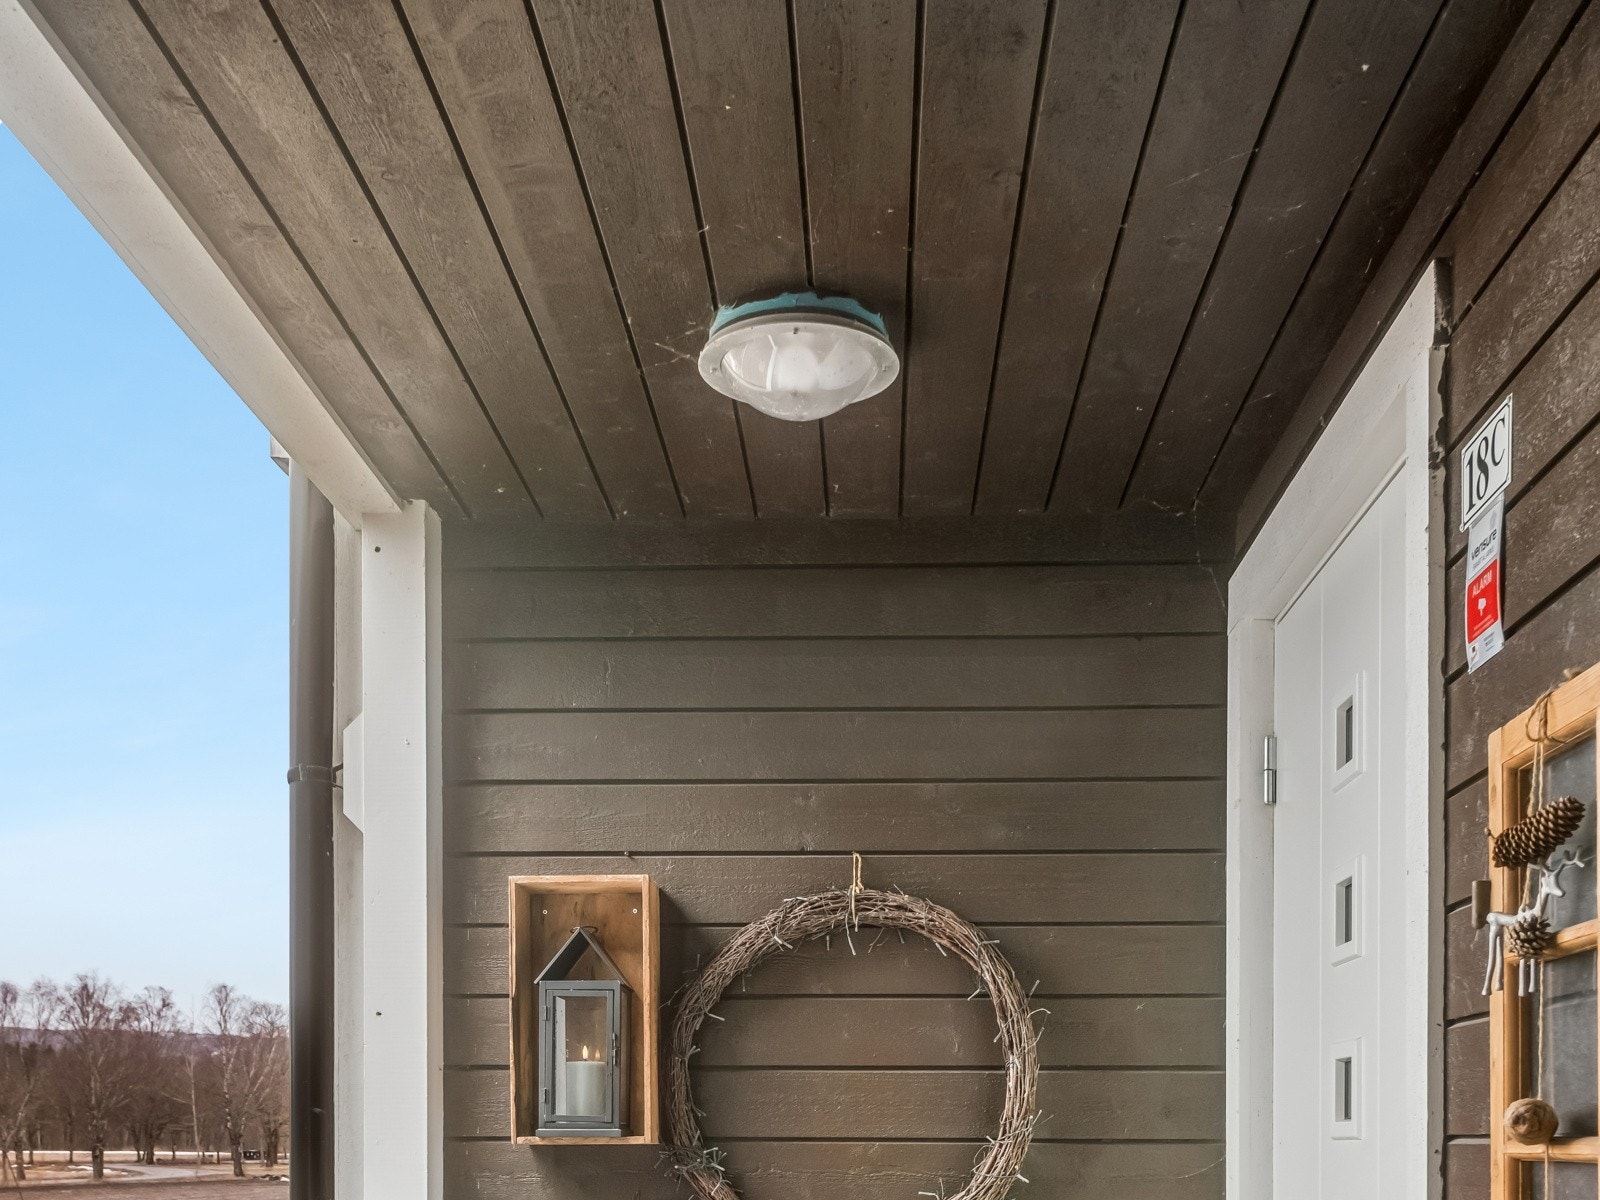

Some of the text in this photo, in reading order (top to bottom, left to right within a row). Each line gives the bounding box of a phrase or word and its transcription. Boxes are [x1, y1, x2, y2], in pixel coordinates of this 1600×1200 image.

[1465, 414, 1505, 515] 18C
[1471, 528, 1497, 560] verisure
[1472, 569, 1493, 598] ALARM
